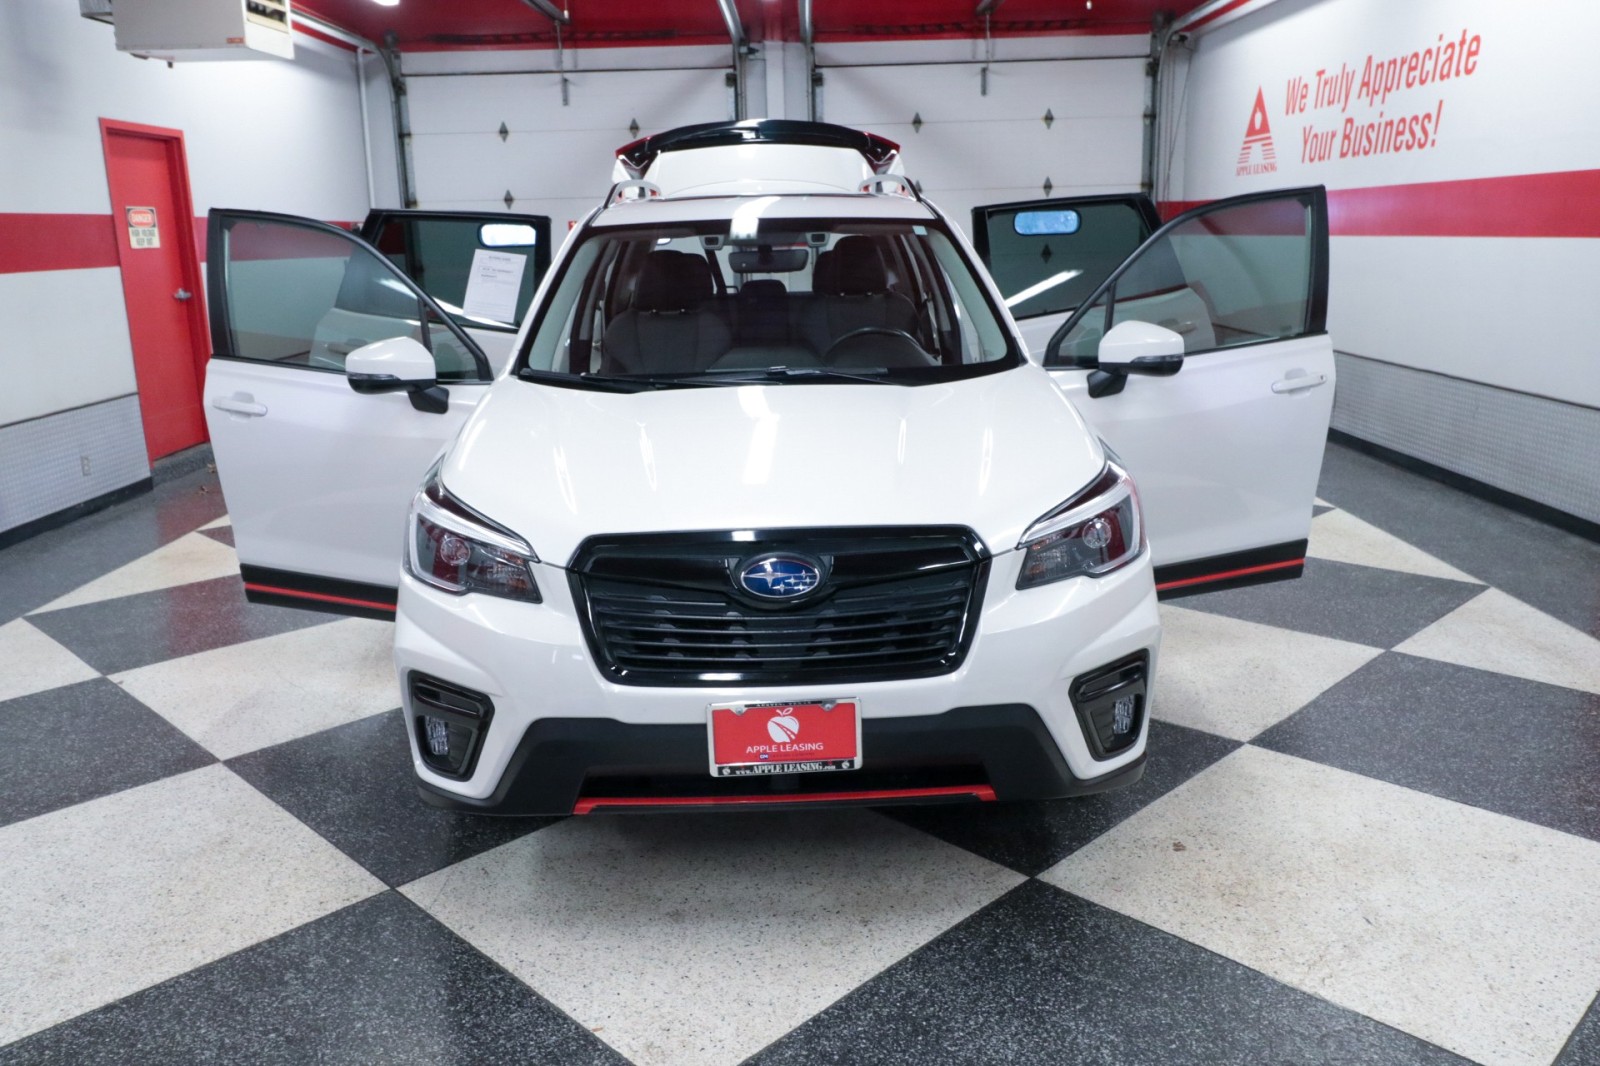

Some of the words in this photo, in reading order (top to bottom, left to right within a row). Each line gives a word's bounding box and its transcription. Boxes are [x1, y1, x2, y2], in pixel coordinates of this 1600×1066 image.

[1286, 76, 1308, 116] We
[1314, 63, 1355, 113] Truly
[1357, 28, 1481, 107] Appreciate
[1301, 125, 1337, 164] Your
[1339, 99, 1443, 159] Business!
[746, 745, 778, 754] APPLE
[780, 742, 824, 752] LEASING
